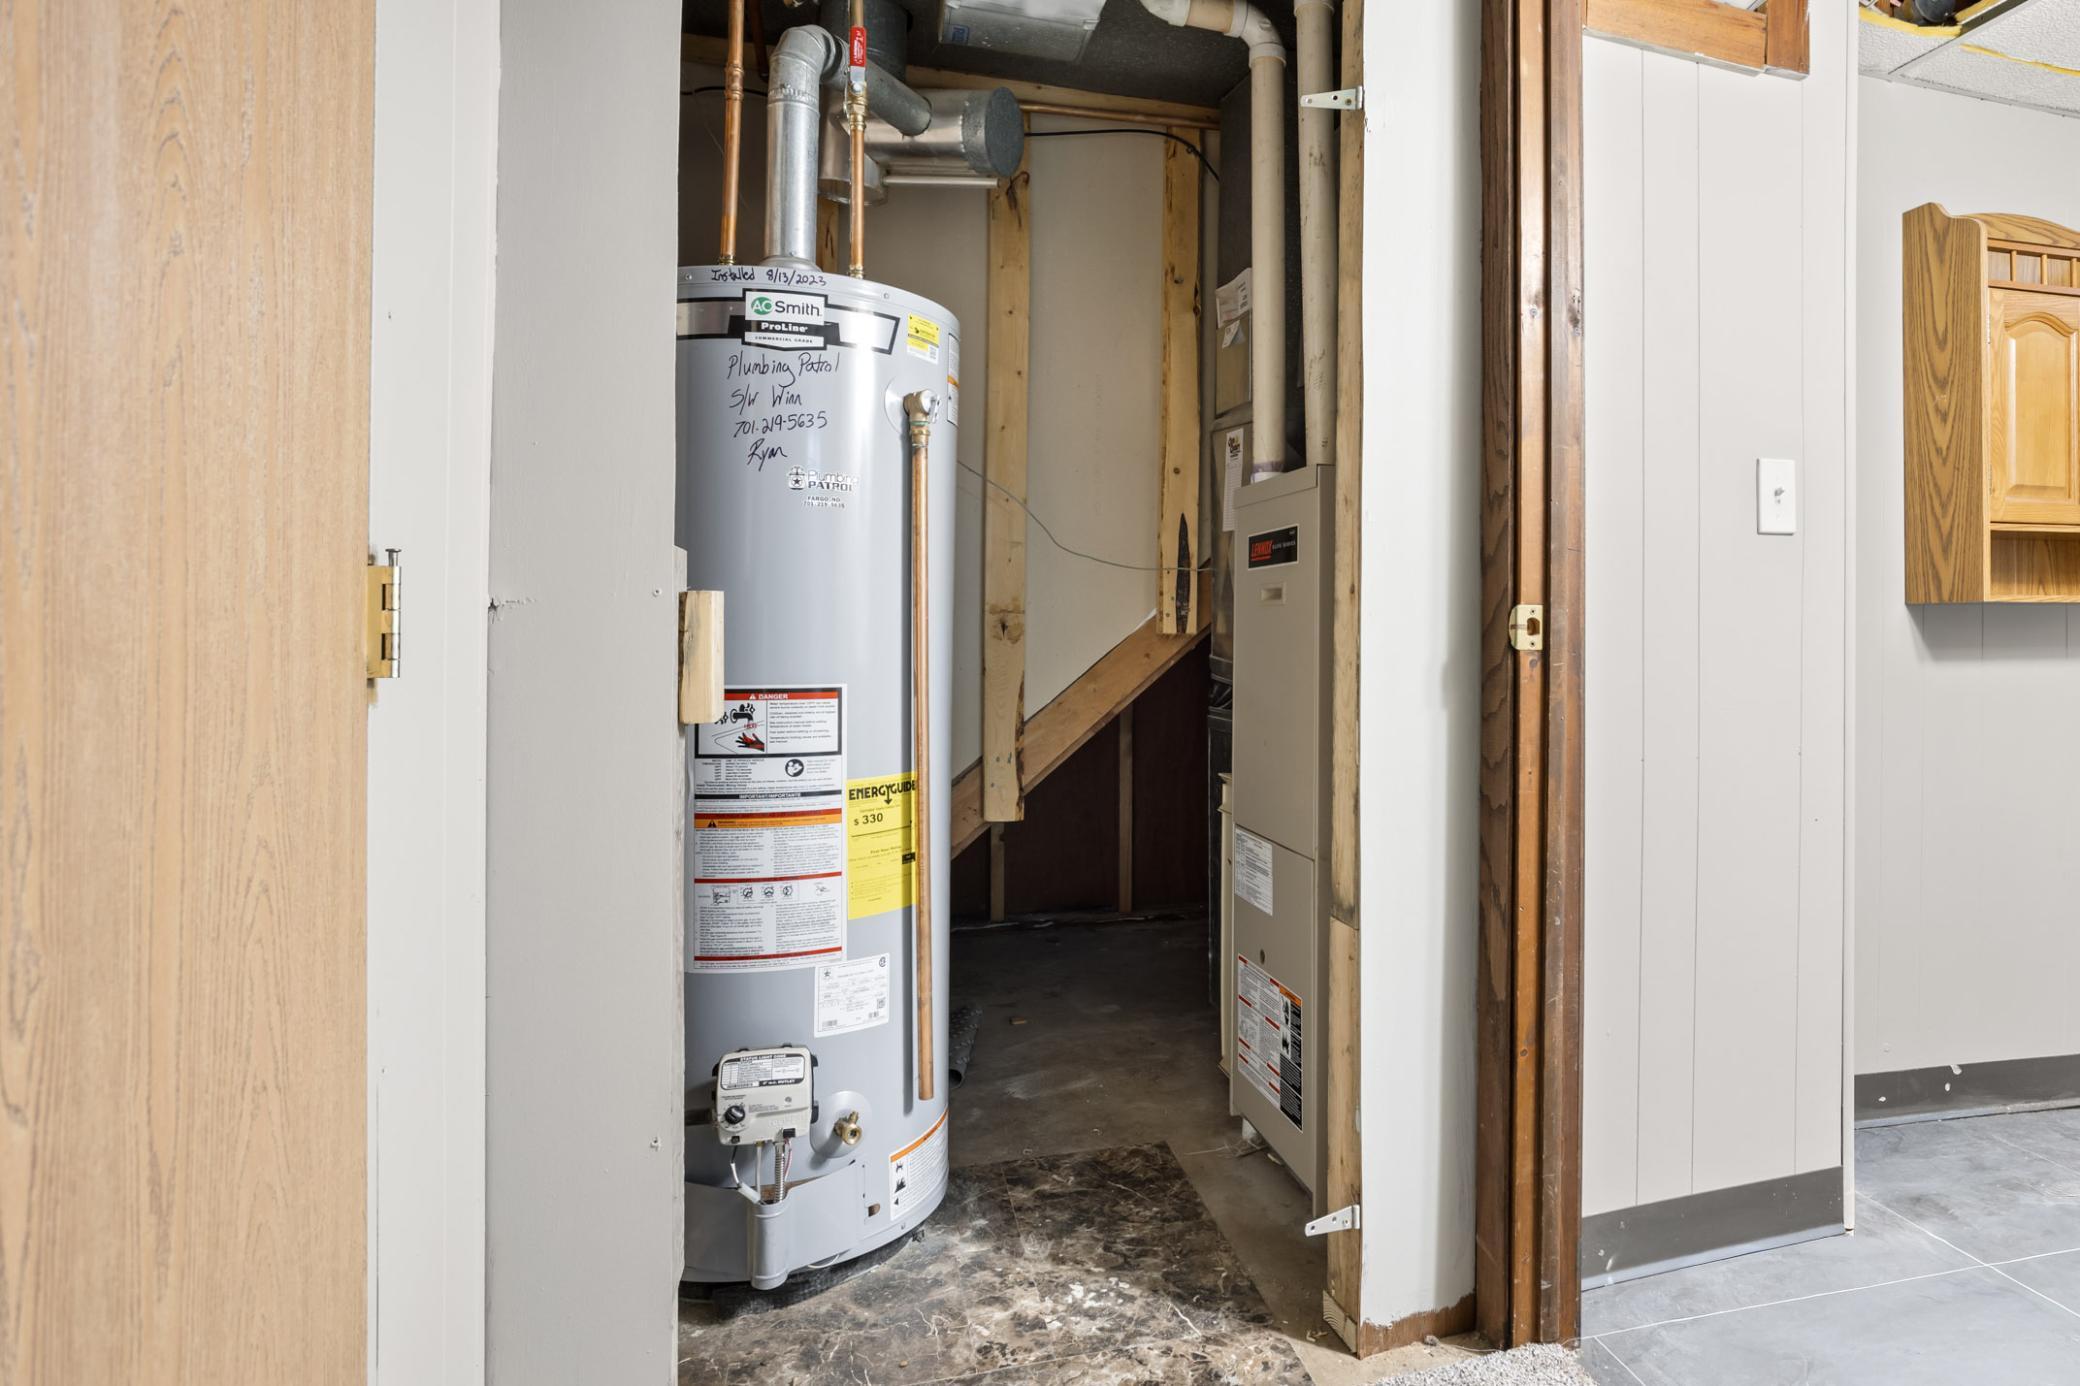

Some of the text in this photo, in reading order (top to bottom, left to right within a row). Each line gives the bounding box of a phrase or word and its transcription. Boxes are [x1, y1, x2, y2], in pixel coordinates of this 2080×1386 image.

[711, 267, 828, 286] Installed 8/13/2023
[774, 300, 820, 317] Smith
[761, 322, 807, 333] ProLine
[726, 350, 840, 388] Plumbing Patrol
[747, 438, 788, 472] Ryan
[758, 693, 789, 701] DANGER
[862, 812, 884, 825] 330
